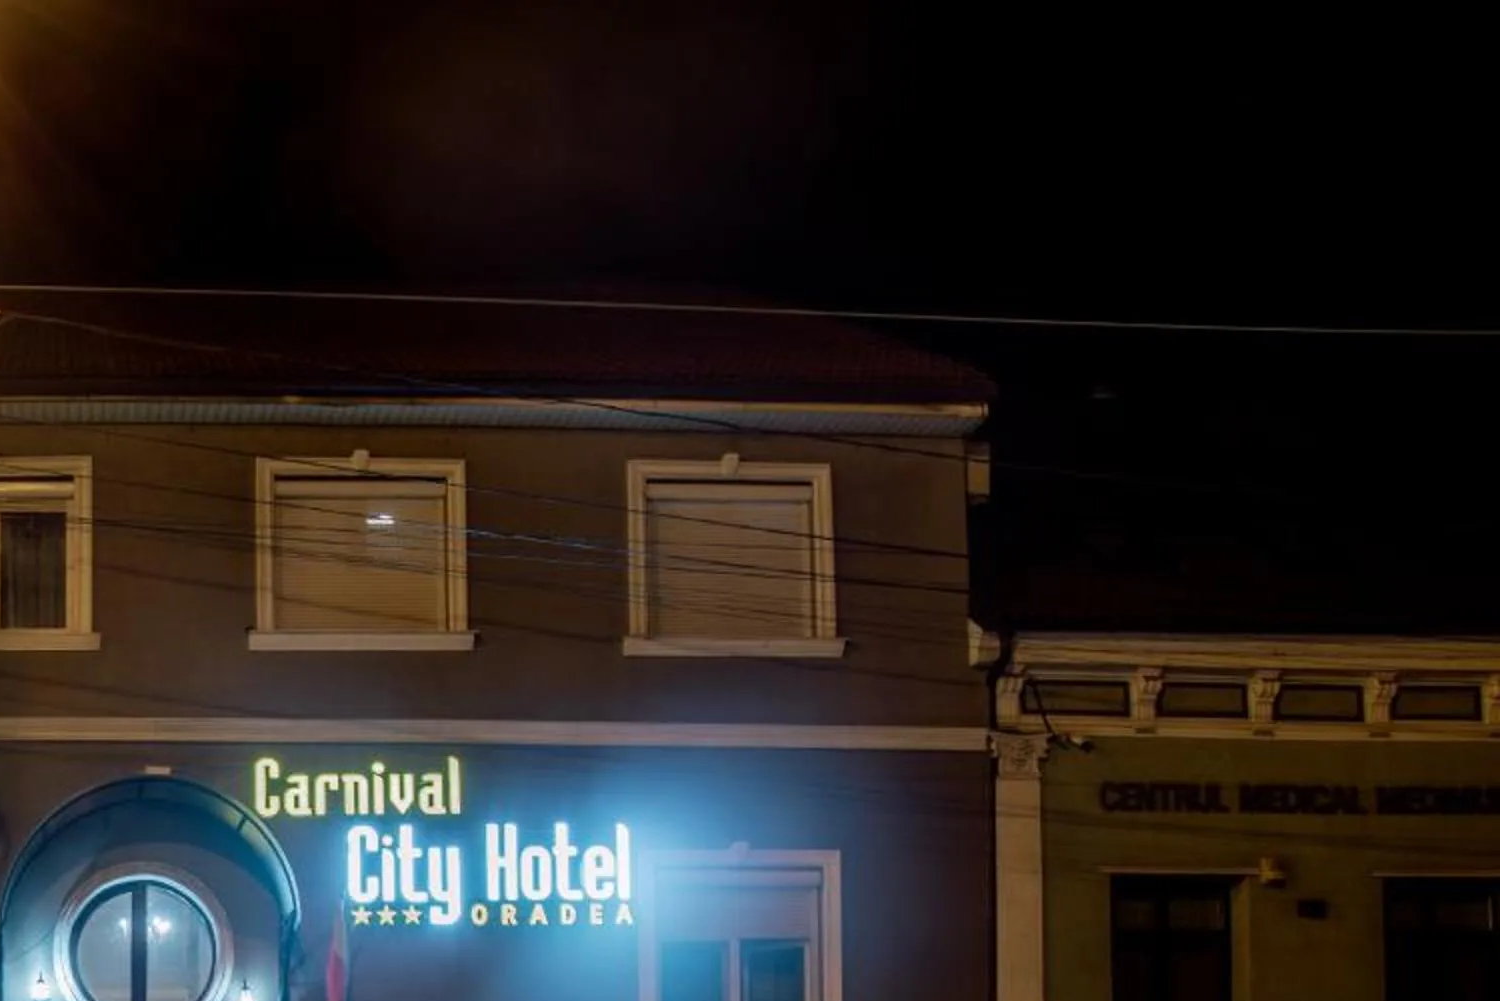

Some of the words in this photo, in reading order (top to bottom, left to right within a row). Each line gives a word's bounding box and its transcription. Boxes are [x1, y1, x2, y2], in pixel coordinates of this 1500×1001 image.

[254, 756, 461, 817] Carnival
[347, 823, 461, 925] City
[486, 821, 632, 903] Hotel
[470, 904, 634, 926] ORADEA
